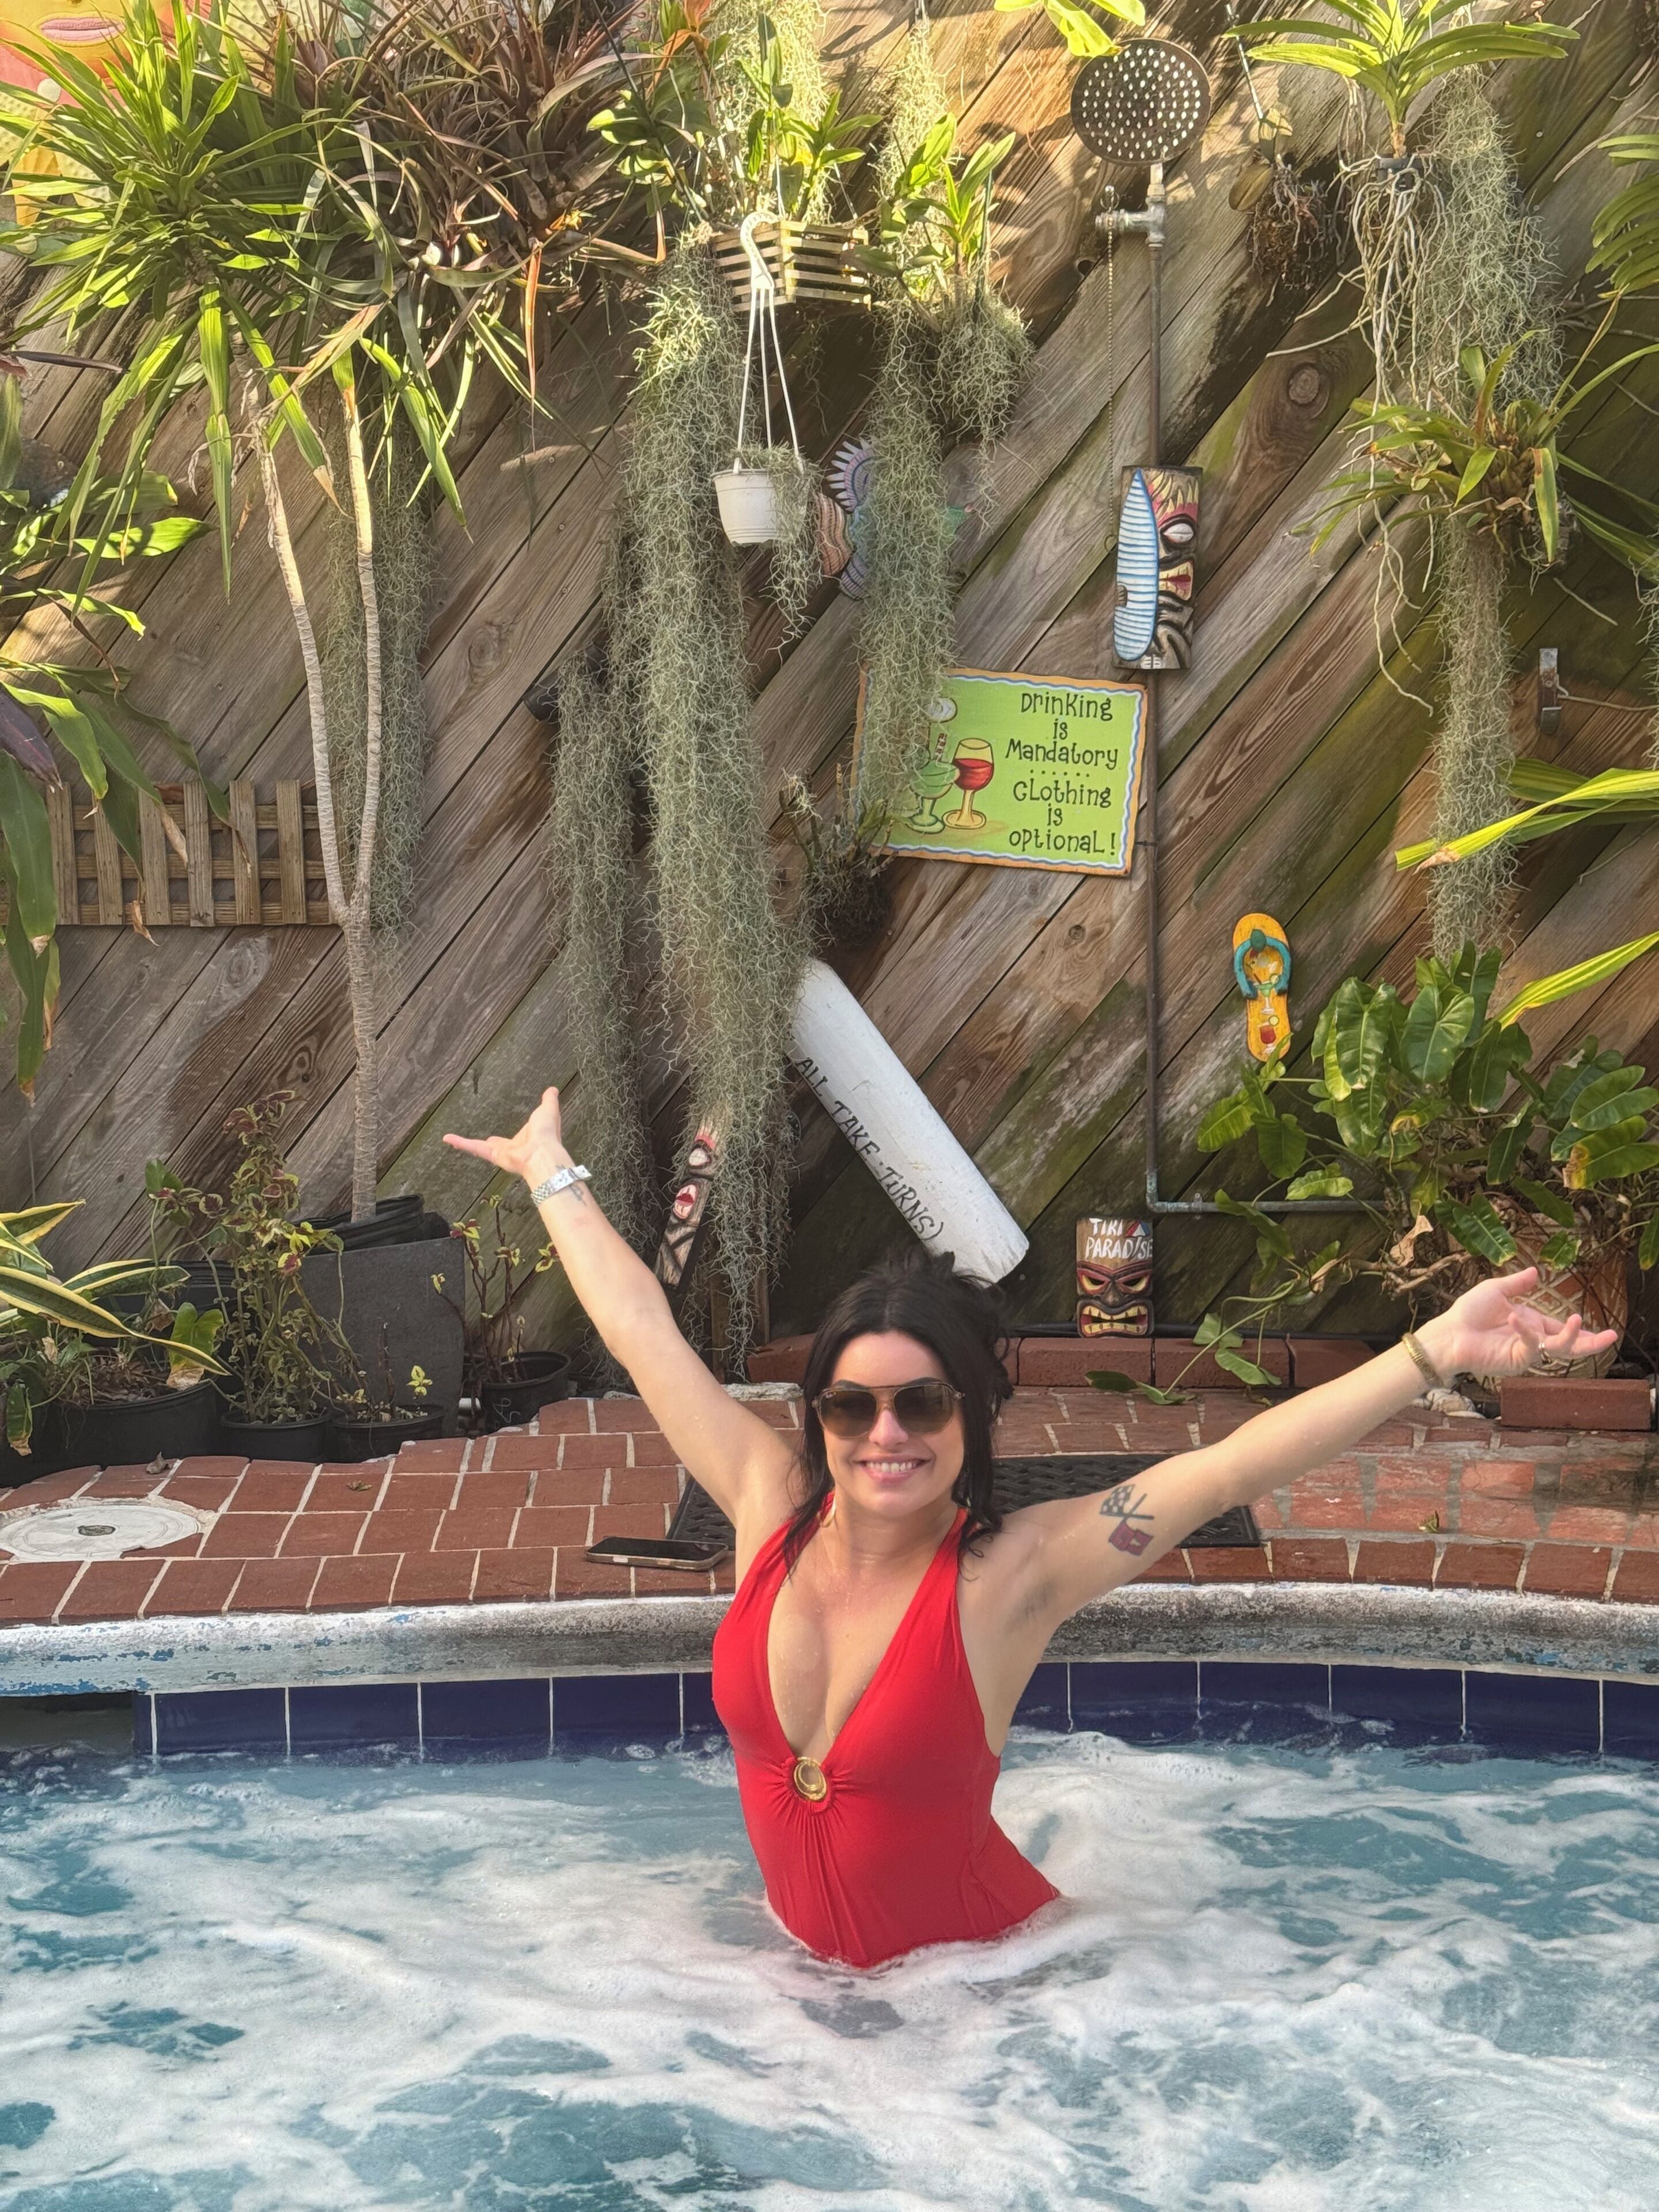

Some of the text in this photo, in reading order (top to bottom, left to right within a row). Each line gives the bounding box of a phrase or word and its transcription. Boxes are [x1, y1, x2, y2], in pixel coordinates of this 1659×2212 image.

[1052, 718, 1068, 740] is
[1005, 738, 1118, 770] Mandatory
[1047, 803, 1063, 826] is
[796, 1057, 828, 1097] ALL
[831, 1100, 880, 1161] TAKE
[1089, 1217, 1123, 1236] TIKI
[1085, 1237, 1153, 1259] PARADISE
